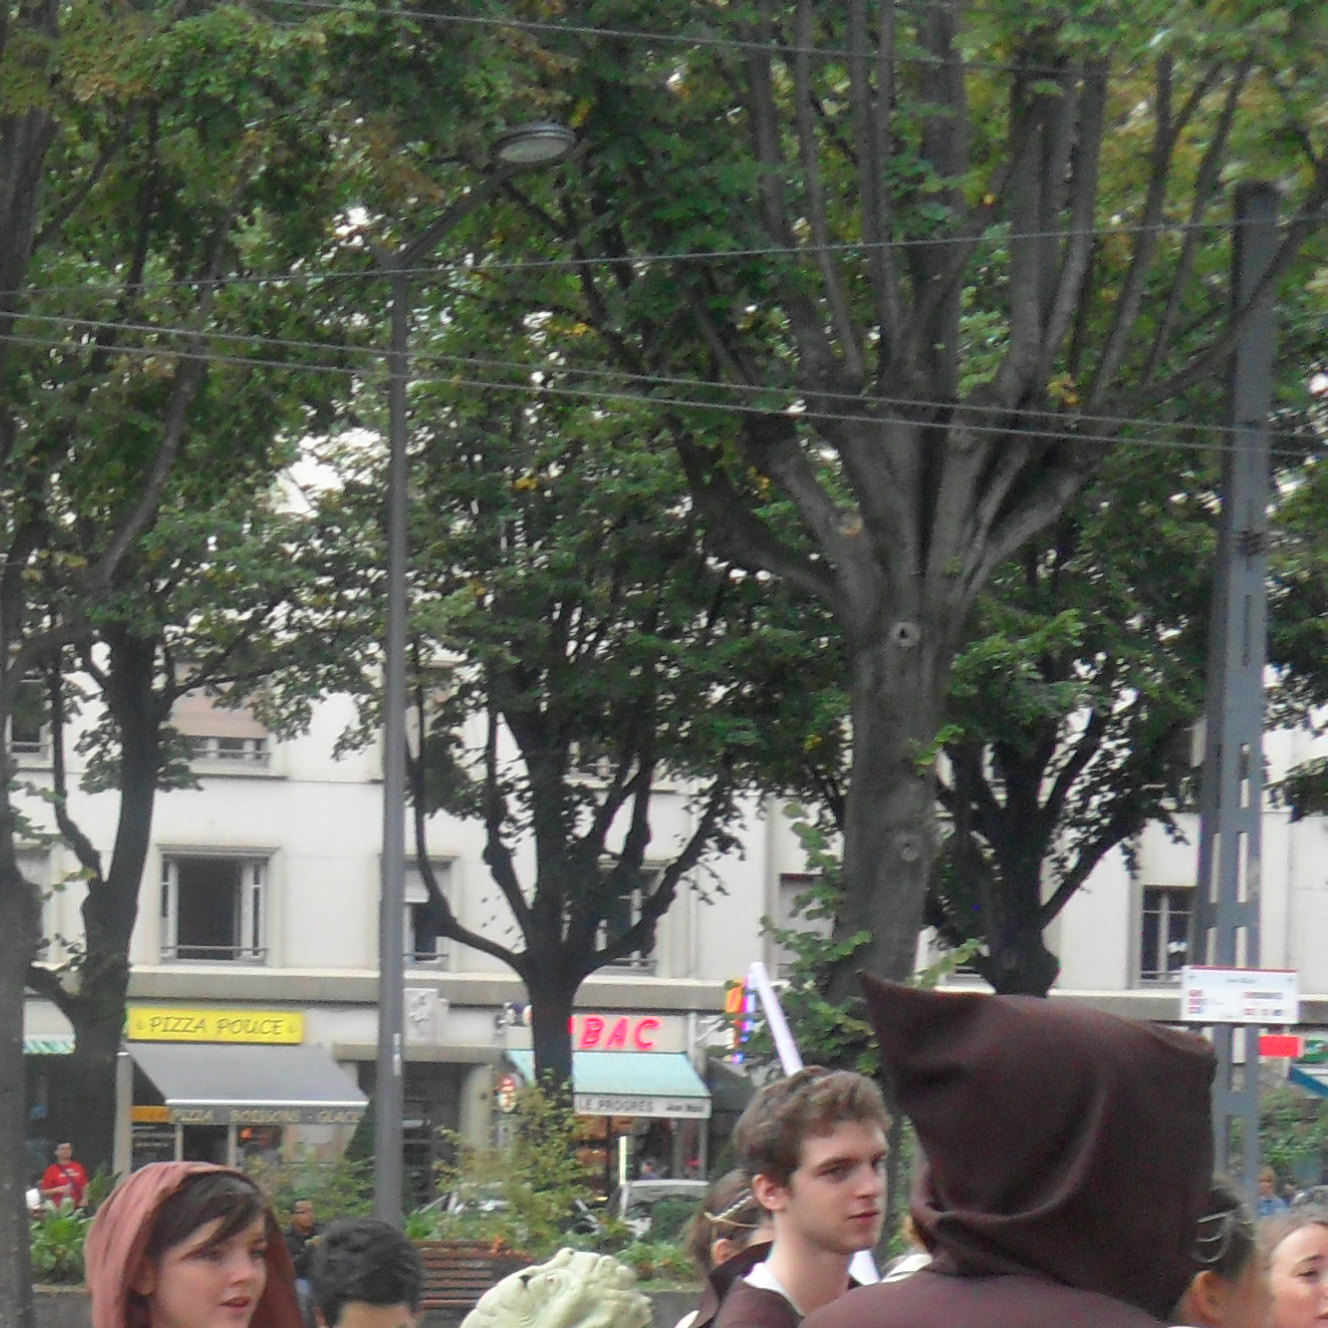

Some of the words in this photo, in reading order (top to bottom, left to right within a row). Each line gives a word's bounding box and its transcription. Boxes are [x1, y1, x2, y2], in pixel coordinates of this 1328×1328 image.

[149, 1016, 207, 1034] PIZZA
[216, 1018, 284, 1036] POUCE
[577, 1014, 663, 1051] BAC
